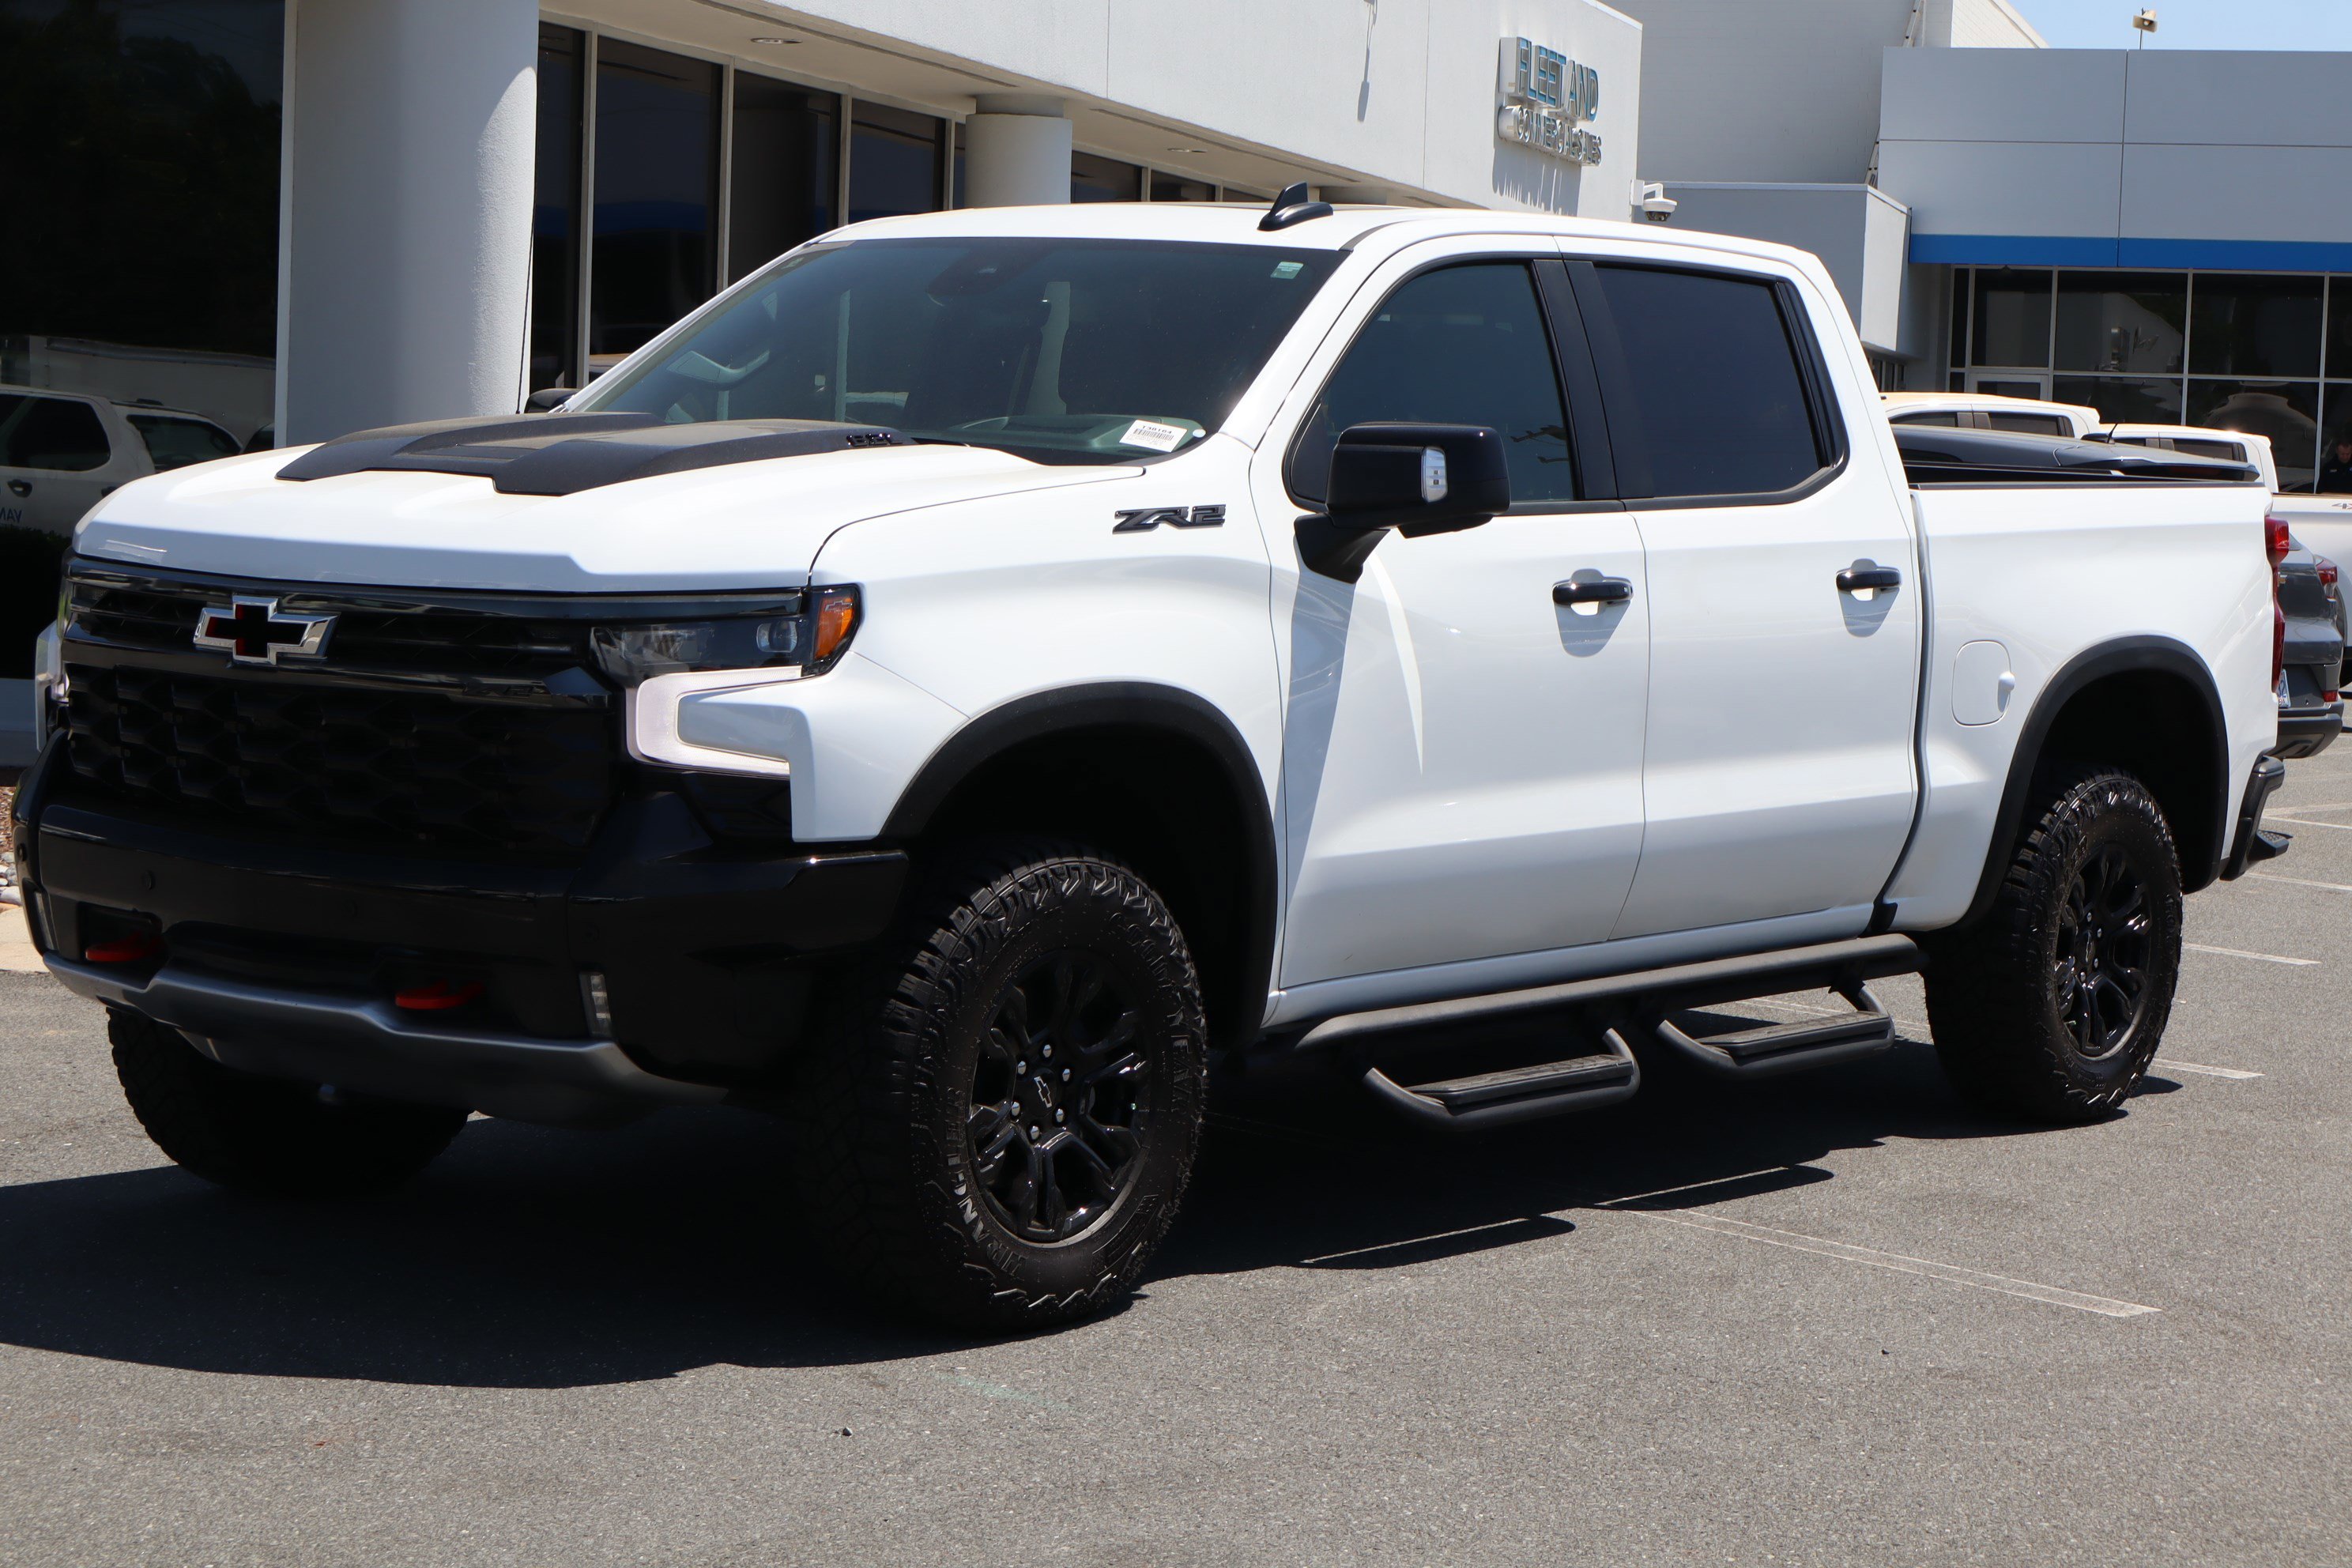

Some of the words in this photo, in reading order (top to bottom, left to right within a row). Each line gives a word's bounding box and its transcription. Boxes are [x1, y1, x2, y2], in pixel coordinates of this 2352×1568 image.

[1515, 36, 1567, 108] FLEET
[1567, 59, 1599, 122] AND
[1112, 504, 1227, 534] ZR2
